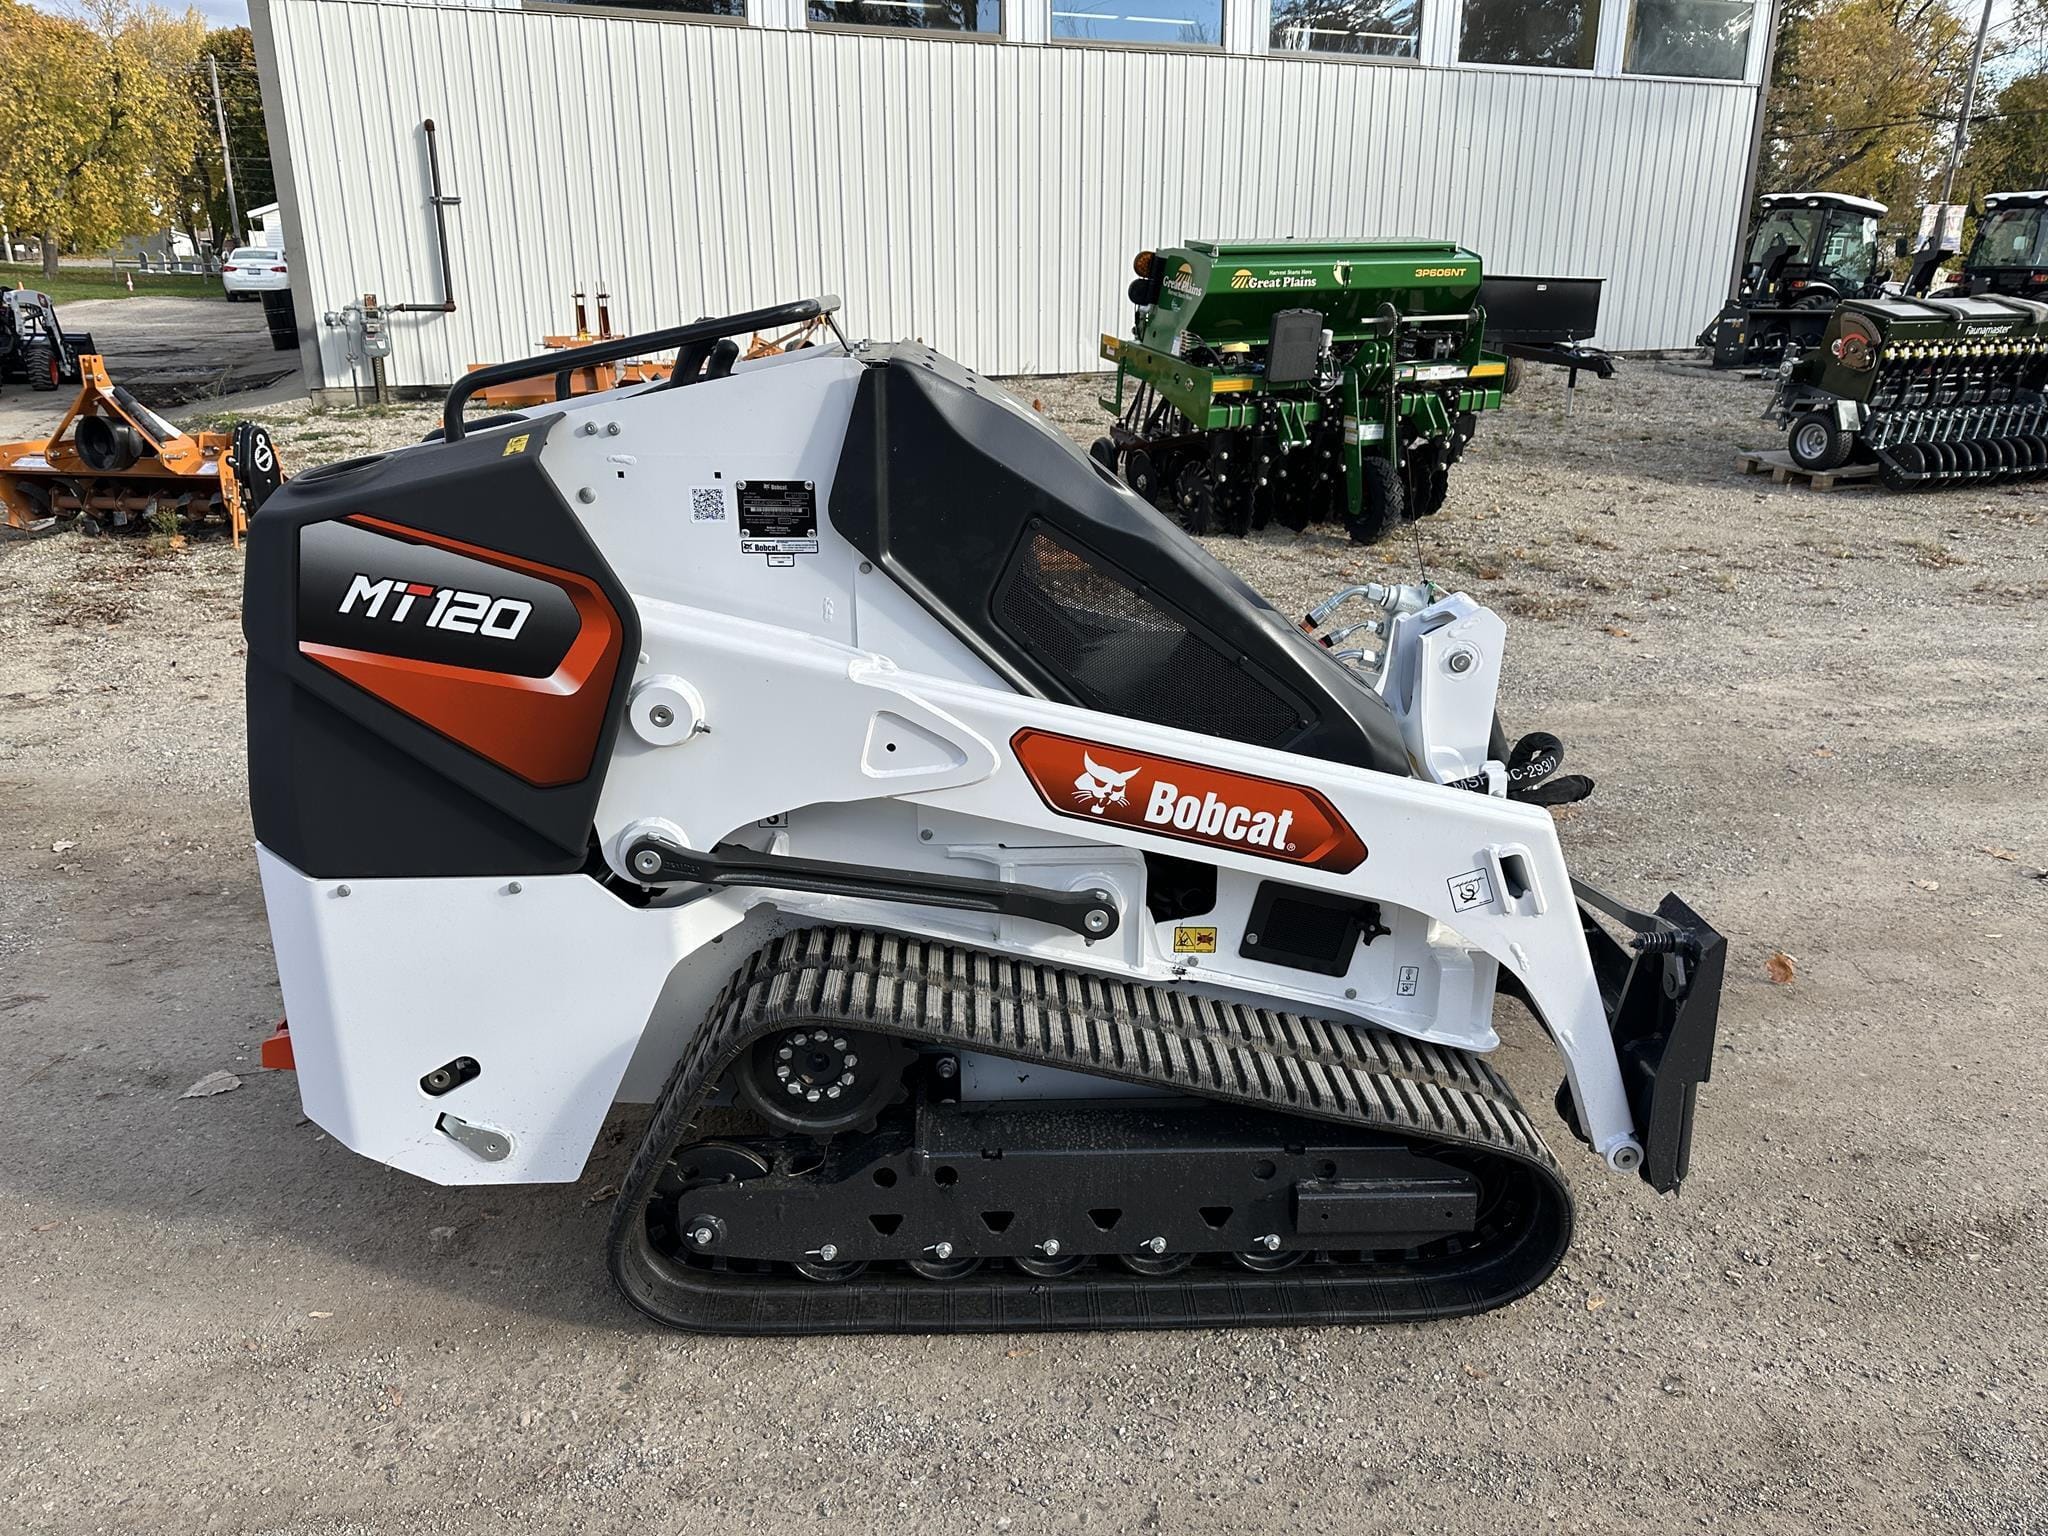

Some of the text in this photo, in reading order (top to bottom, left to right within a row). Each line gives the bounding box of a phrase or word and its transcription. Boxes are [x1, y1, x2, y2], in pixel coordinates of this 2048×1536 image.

[1415, 268, 1467, 278] 3P606NT
[1162, 275, 1181, 291] Great
[1181, 280, 1202, 297] Plains
[1248, 276, 1317, 289] Great Plains
[754, 544, 781, 552] Bobcat
[338, 574, 533, 641] MT120
[1144, 780, 1294, 851] Bobcat
